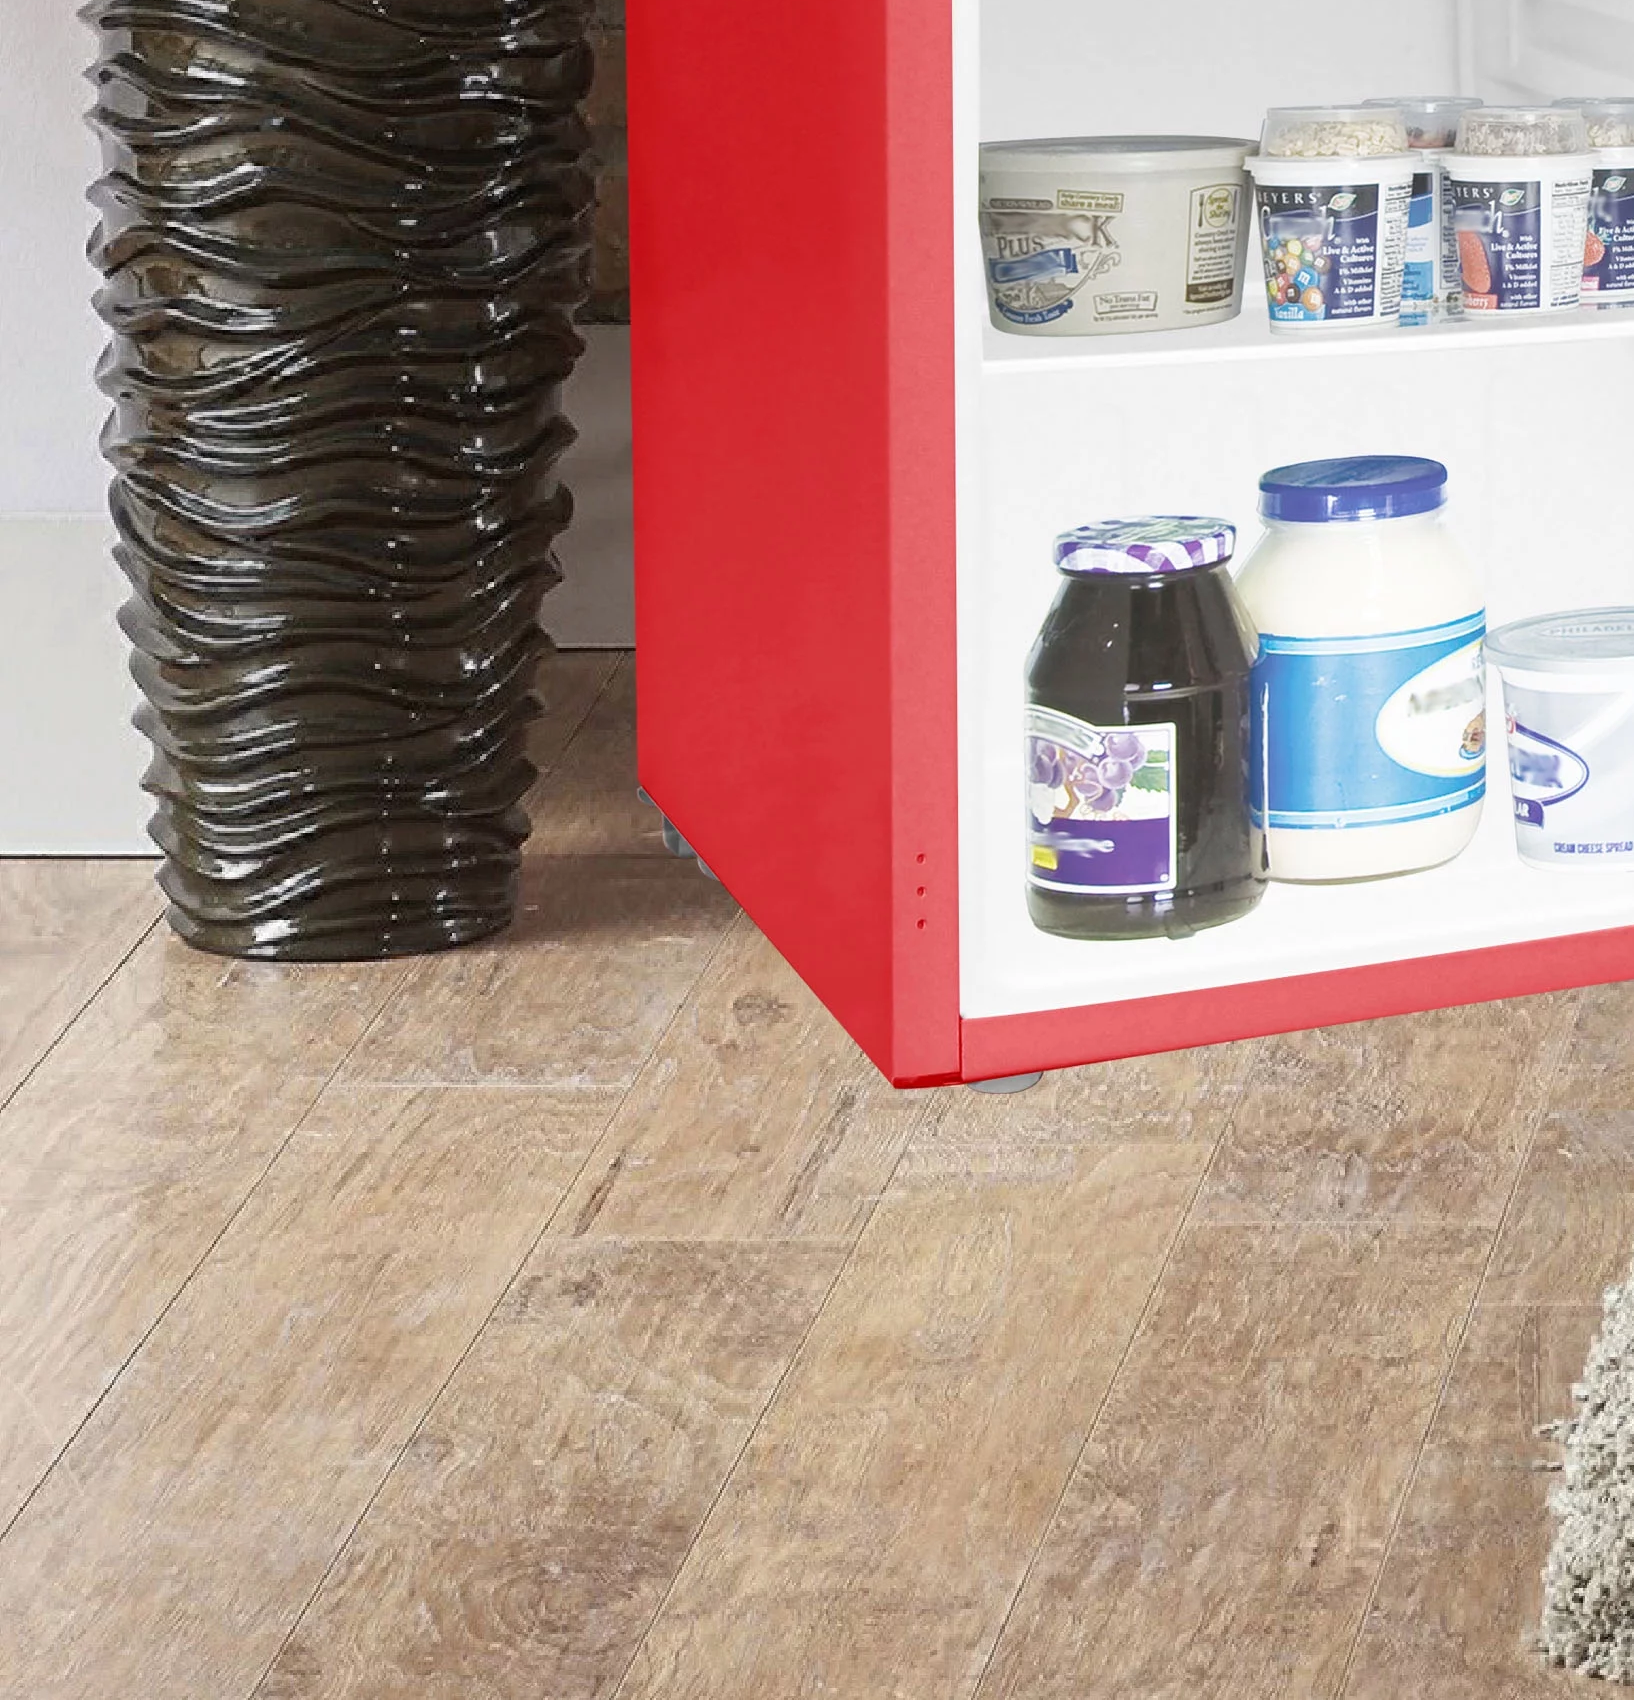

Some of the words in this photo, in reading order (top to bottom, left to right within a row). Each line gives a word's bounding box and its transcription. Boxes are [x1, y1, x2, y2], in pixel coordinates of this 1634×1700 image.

[996, 235, 1045, 259] PLUS
[1553, 842, 1576, 854] CREAM
[1577, 842, 1604, 854] CHEESE
[1605, 841, 1634, 853] SPREAD
